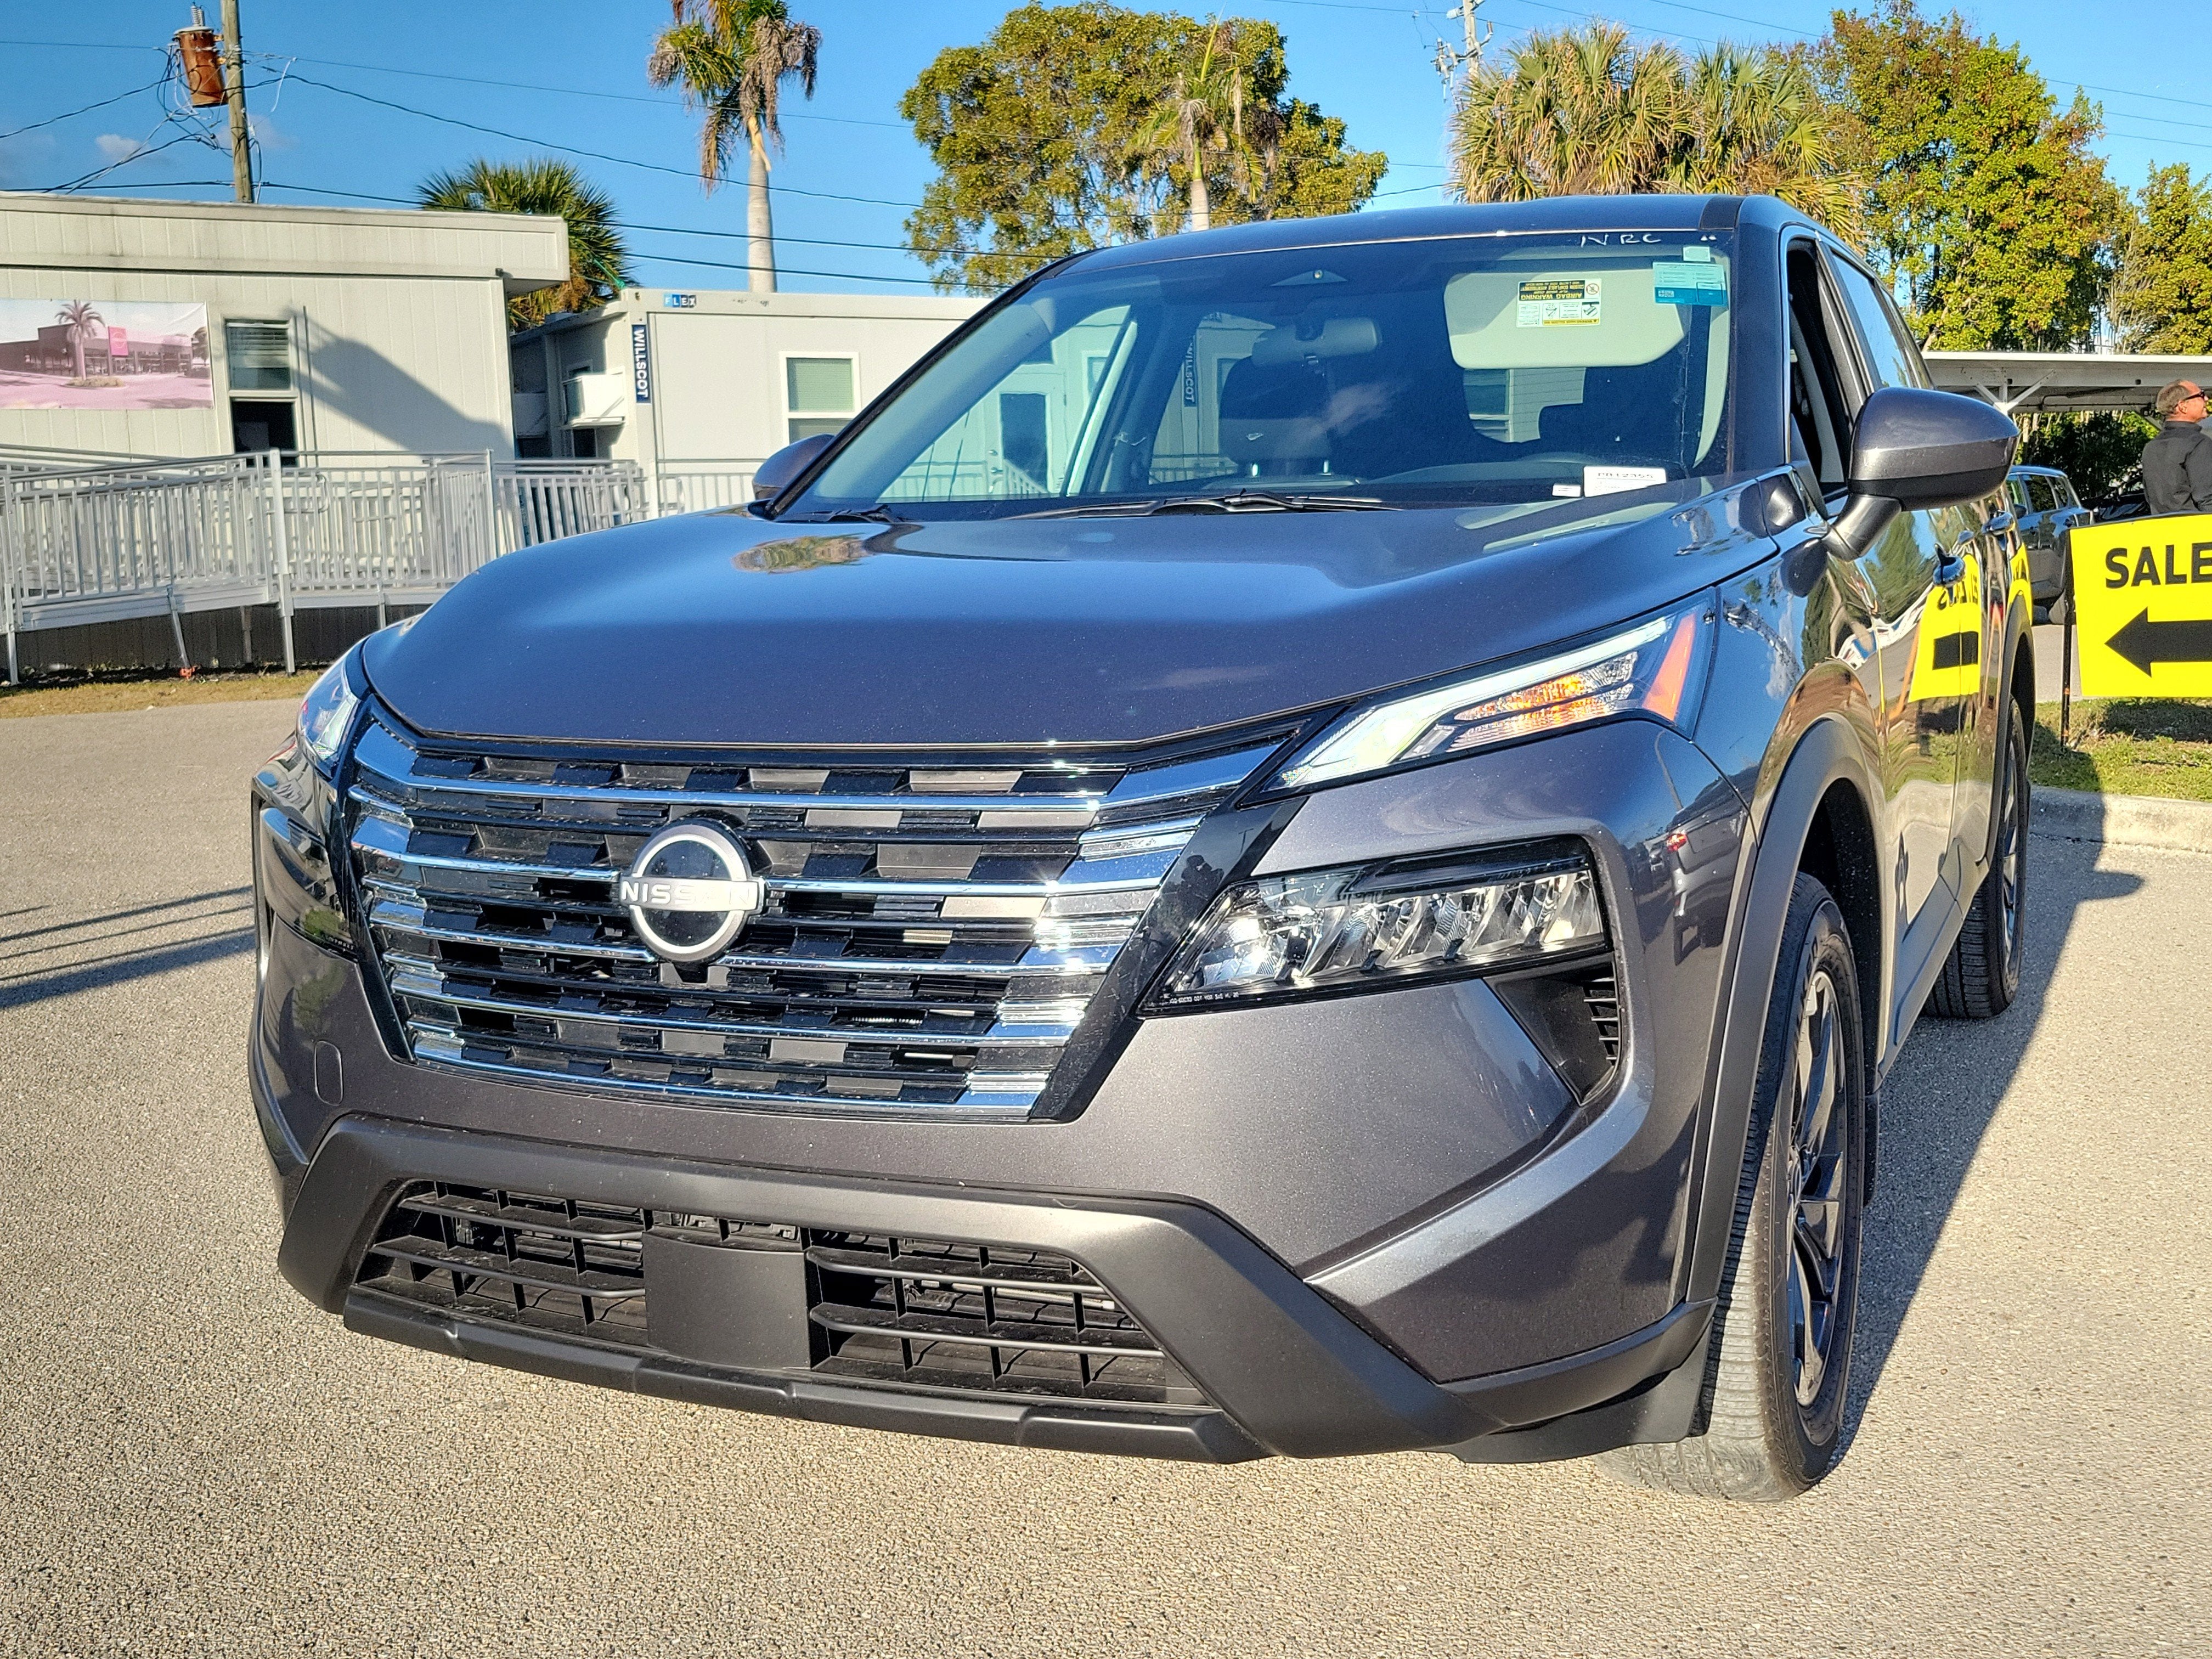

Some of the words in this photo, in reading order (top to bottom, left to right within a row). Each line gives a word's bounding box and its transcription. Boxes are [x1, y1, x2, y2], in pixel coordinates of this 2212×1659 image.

[664, 295, 696, 306] FLEX
[634, 329, 648, 398] WILLSCOT
[2105, 541, 2212, 589] SALE
[621, 880, 750, 905] NISSN
